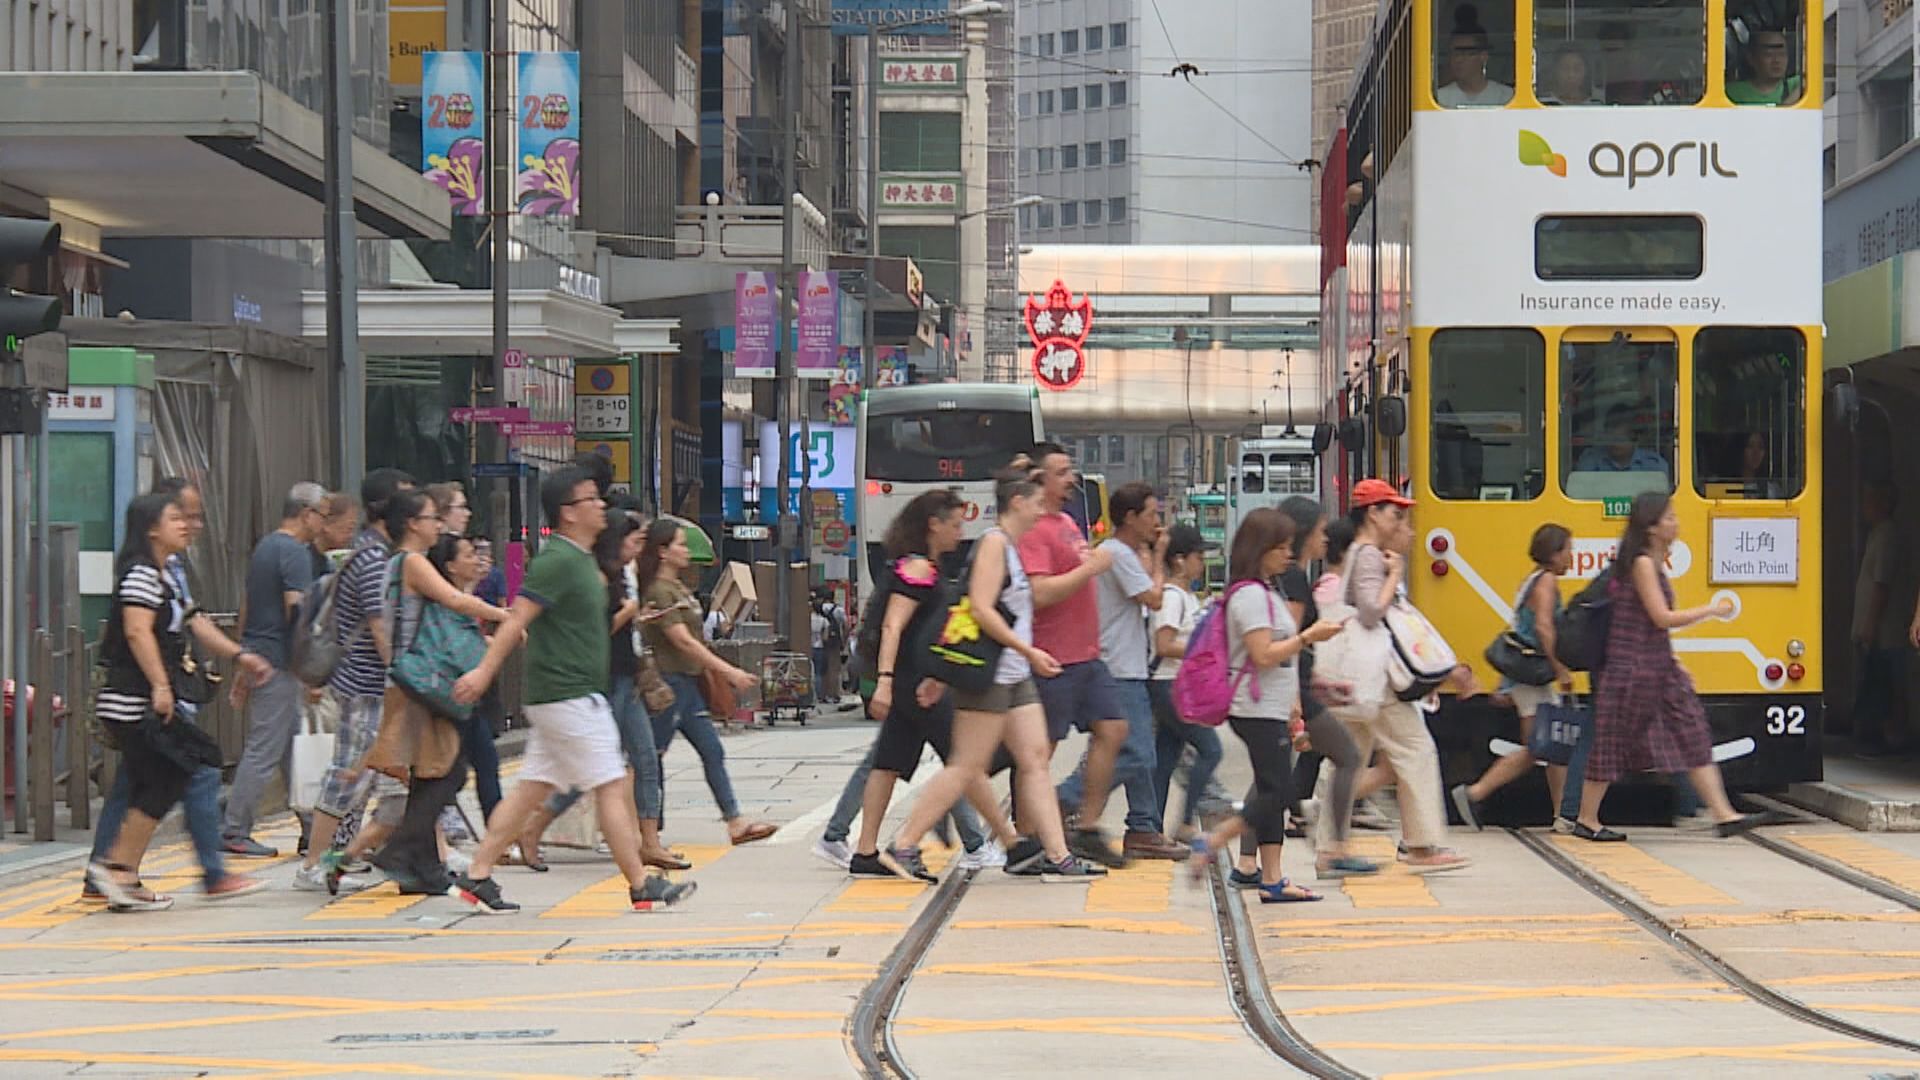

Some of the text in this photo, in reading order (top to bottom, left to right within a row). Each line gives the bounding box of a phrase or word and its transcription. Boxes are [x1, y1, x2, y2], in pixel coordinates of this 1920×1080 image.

[832, 9, 948, 24] STATIONERS
[1520, 293, 1727, 314] Insurance made easy.
[938, 459, 964, 477] 914
[1735, 530, 1775, 553] 北角
[1721, 560, 1789, 575] North Point
[1766, 706, 1806, 735] 32
